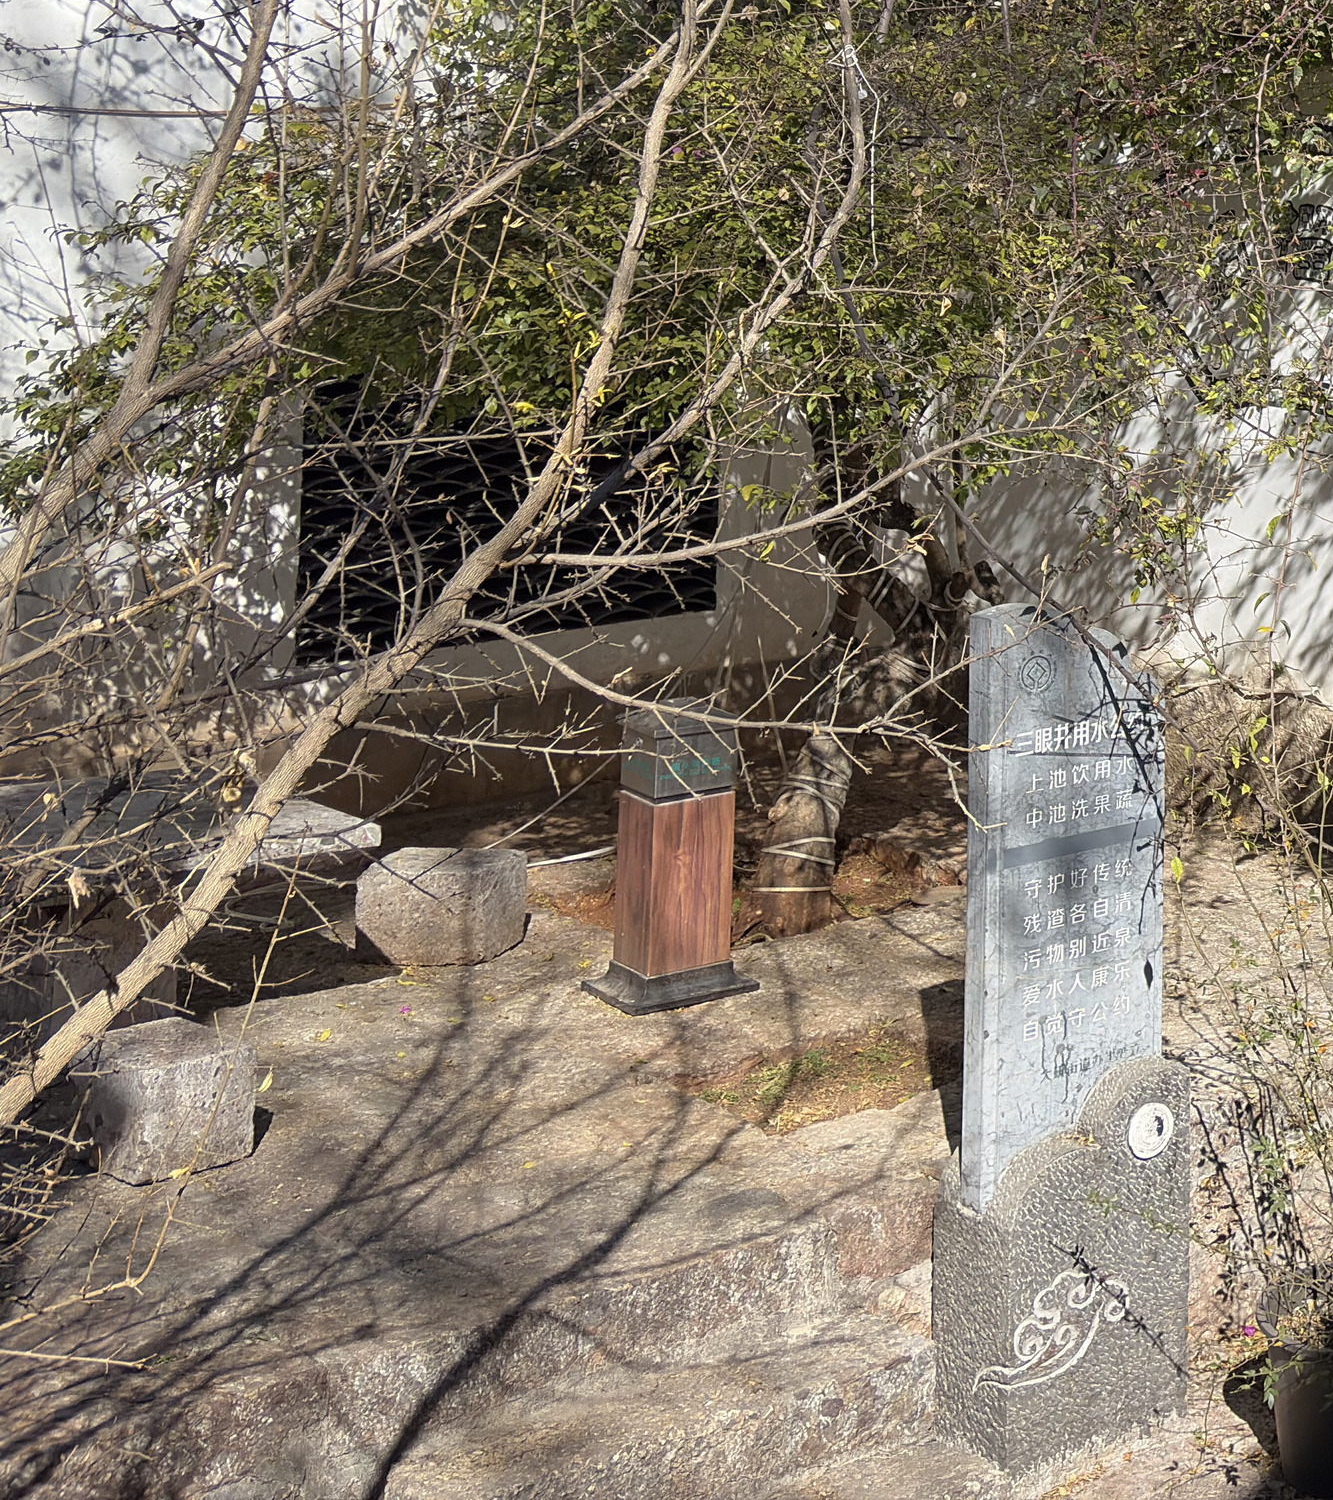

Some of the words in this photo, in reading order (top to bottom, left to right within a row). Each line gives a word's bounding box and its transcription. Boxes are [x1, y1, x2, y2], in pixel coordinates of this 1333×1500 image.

[1026, 755, 1134, 794] 上池饮用水
[1026, 788, 1133, 829] 中池洗果蔬
[1024, 859, 1133, 899] 守护好传统
[1023, 891, 1132, 936] 残渣各自清
[1023, 927, 1132, 972] 污物别近泉
[1022, 960, 1131, 1007] 爱水人康乐
[1023, 995, 1130, 1042] 自觉守公约
